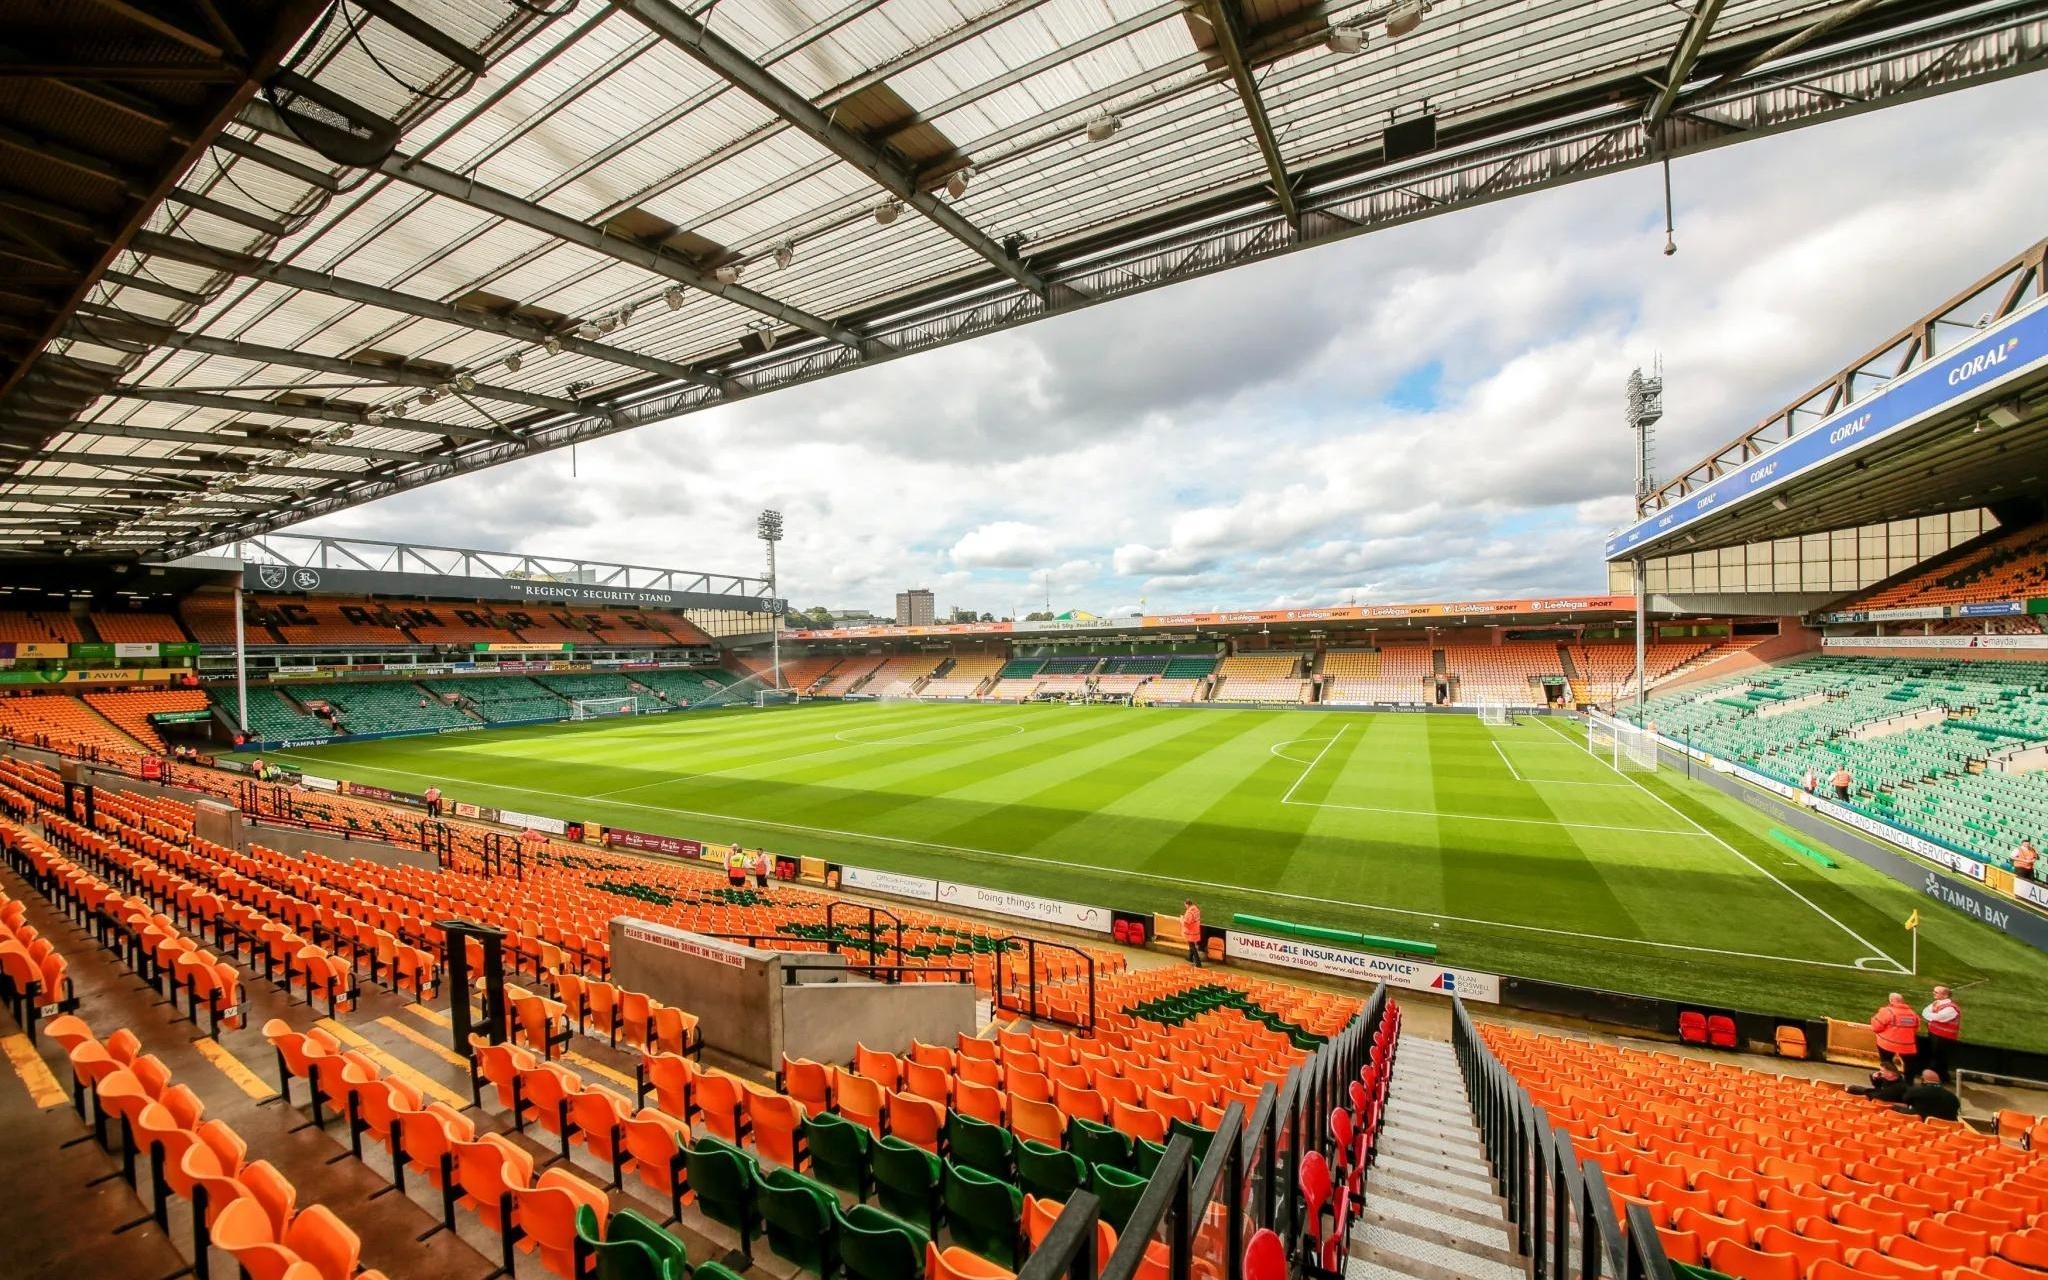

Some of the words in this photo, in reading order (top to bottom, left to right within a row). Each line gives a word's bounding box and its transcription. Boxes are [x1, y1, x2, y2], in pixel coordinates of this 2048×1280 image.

[1948, 343, 2009, 386] CORAL
[1830, 416, 1866, 445] CORAL
[1750, 463, 1773, 484] CORAL
[526, 586, 579, 597] REGENCY
[583, 590, 636, 601] SECURITY
[640, 593, 672, 603] STAND
[1410, 607, 1431, 615] SPORT
[94, 671, 129, 679] AVIVA
[1854, 813, 1871, 829] AND
[1872, 821, 1915, 849] FINANCIAL
[1917, 841, 1962, 869] SERVICES
[977, 890, 1004, 905] Doing
[1006, 896, 1036, 910] things
[1039, 902, 1063, 915] right
[1941, 886, 1981, 917] TAMPA
[1984, 905, 2009, 929] BAY
[625, 928, 643, 940] PLEASE
[681, 942, 701, 955] DRINKS
[702, 948, 710, 957] ON
[711, 950, 724, 961] THIS
[725, 954, 743, 967] LEDGE
[1302, 947, 1366, 967] INSURANCE
[1269, 953, 1290, 962] 01603
[1292, 957, 1318, 968] 218000
[1324, 963, 1411, 984] www.alanboswell.com
[1457, 975, 1477, 983] ALAN
[1457, 981, 1489, 991] BOSWELL
[1457, 987, 1485, 995] GROUP
